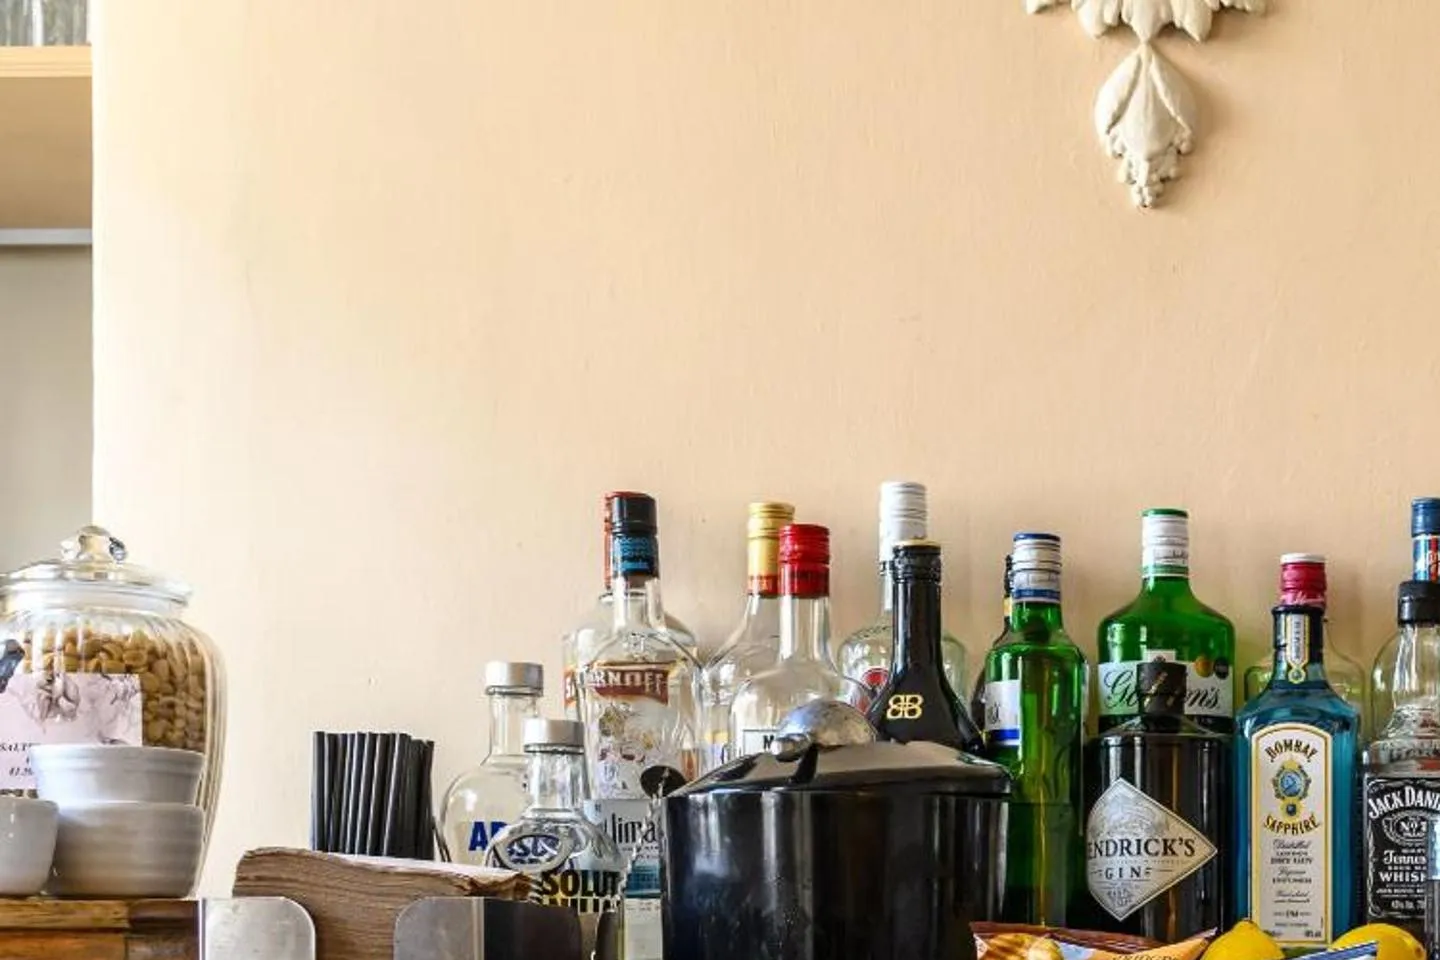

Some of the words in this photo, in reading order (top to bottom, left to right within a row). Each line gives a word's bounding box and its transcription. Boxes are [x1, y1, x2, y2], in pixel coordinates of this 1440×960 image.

[1264, 739, 1318, 761] BOMBAY
[1368, 791, 1402, 819] JACK
[1263, 812, 1321, 834] SAPPHIRE
[1087, 838, 1195, 858] ENDRICK'S
[541, 869, 621, 898] SOLUT
[1105, 866, 1141, 880] GIN
